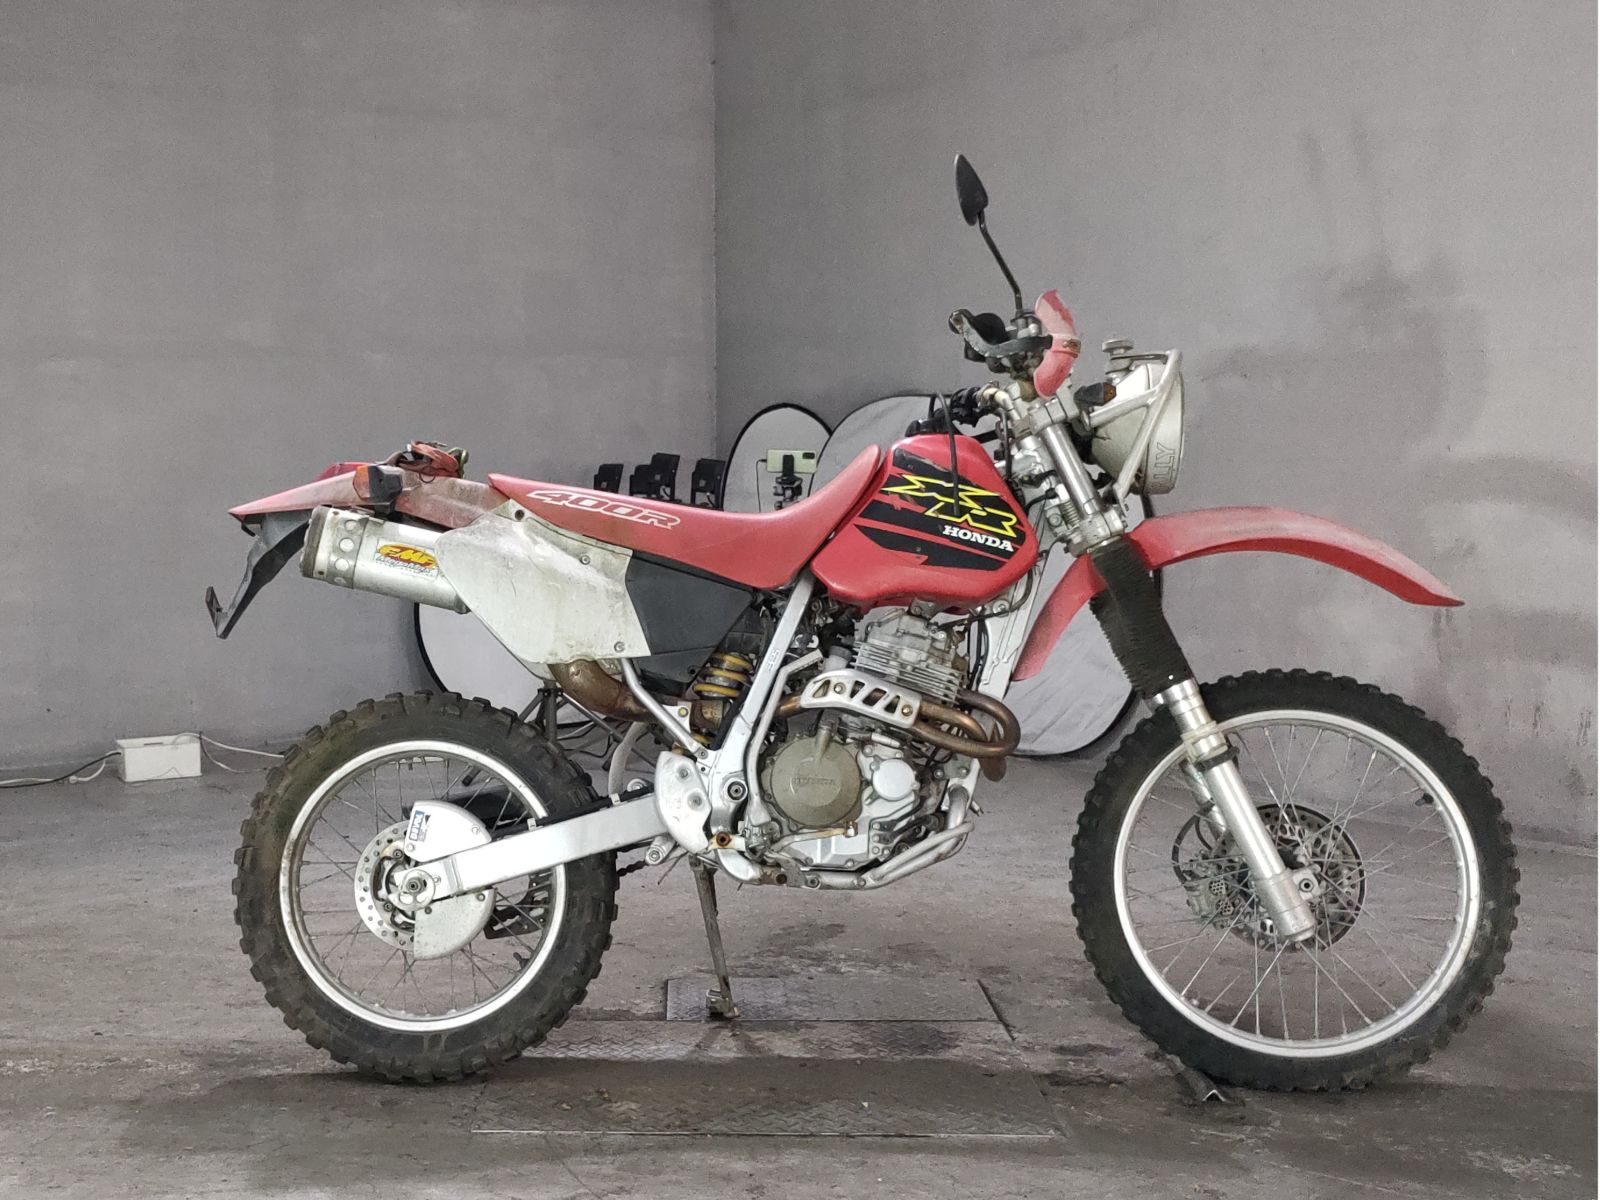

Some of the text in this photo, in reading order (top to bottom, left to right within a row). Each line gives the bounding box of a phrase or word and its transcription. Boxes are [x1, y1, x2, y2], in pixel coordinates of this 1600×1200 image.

[527, 490, 680, 529] 400R
[942, 525, 1014, 552] HONDA
[378, 545, 436, 567] FMF
